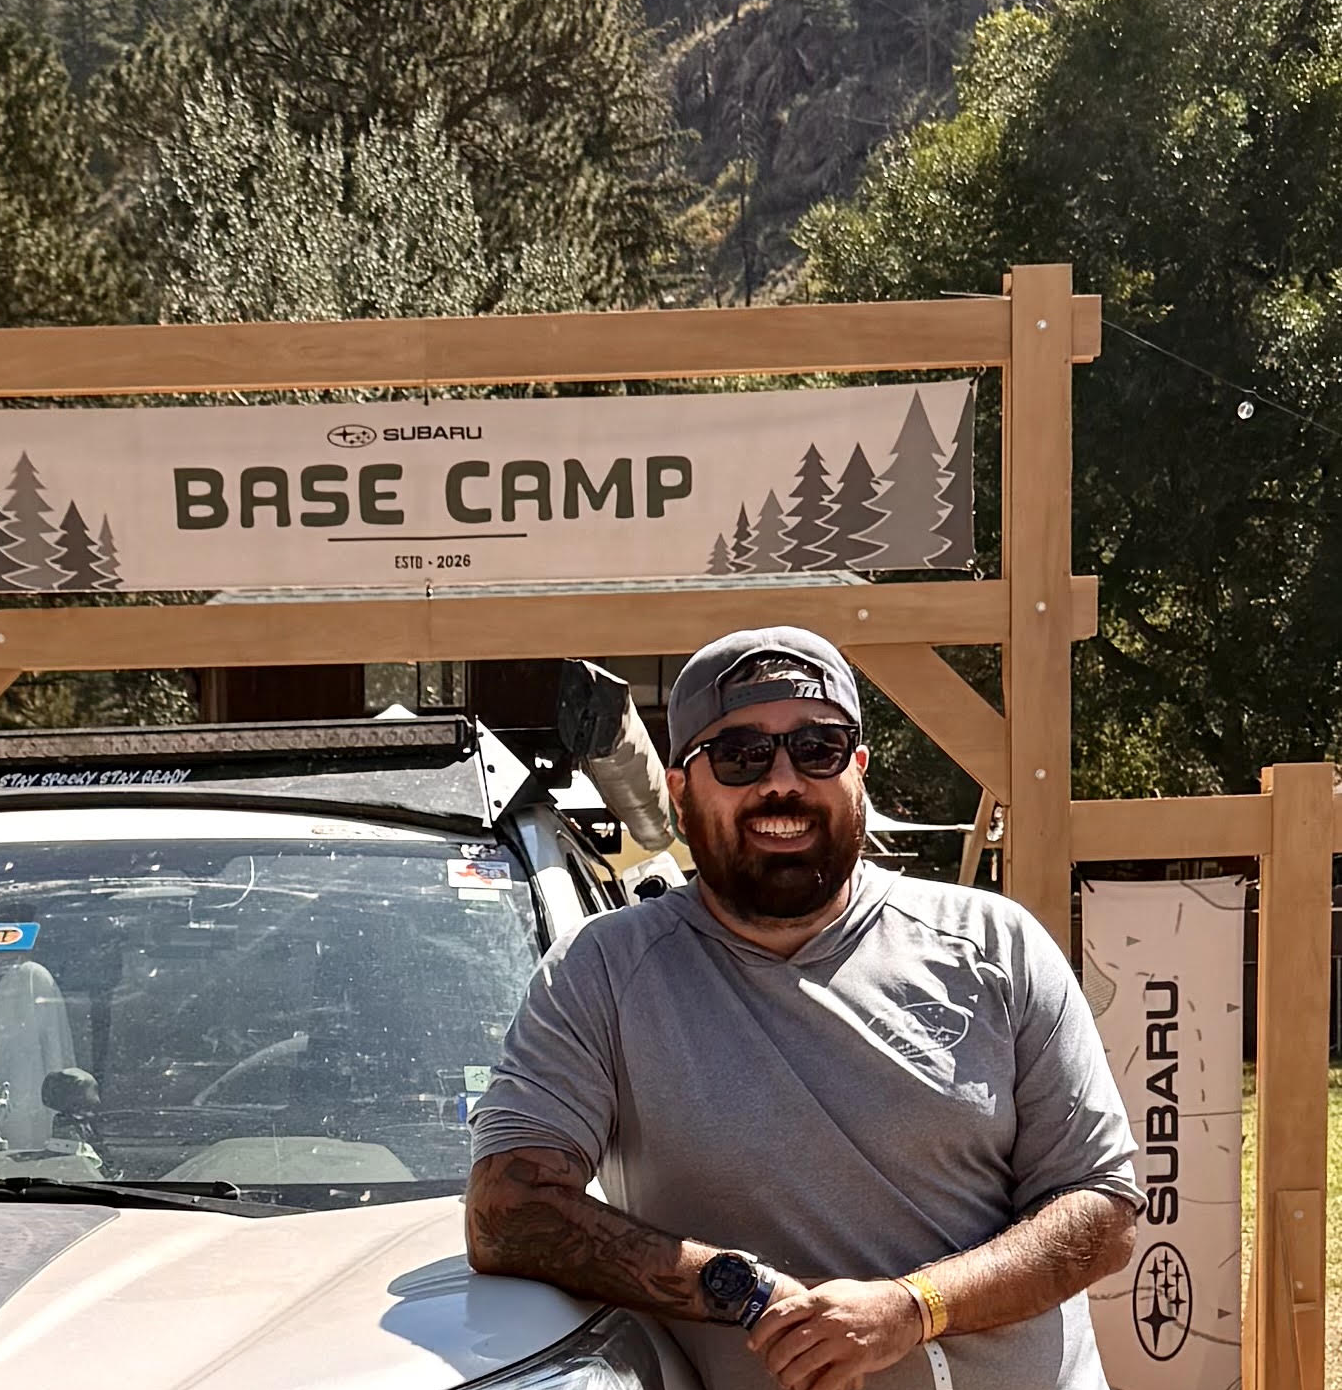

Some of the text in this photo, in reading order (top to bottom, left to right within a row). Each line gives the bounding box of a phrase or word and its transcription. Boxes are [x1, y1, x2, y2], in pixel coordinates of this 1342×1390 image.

[383, 426, 483, 441] SUBARU
[172, 456, 694, 530] BASE CAMP
[395, 555, 471, 570] ESTD 2026
[0, 773, 40, 788] STAY
[99, 769, 140, 785] STAY
[141, 769, 192, 785] READY
[1145, 980, 1179, 1226] SUBARU
